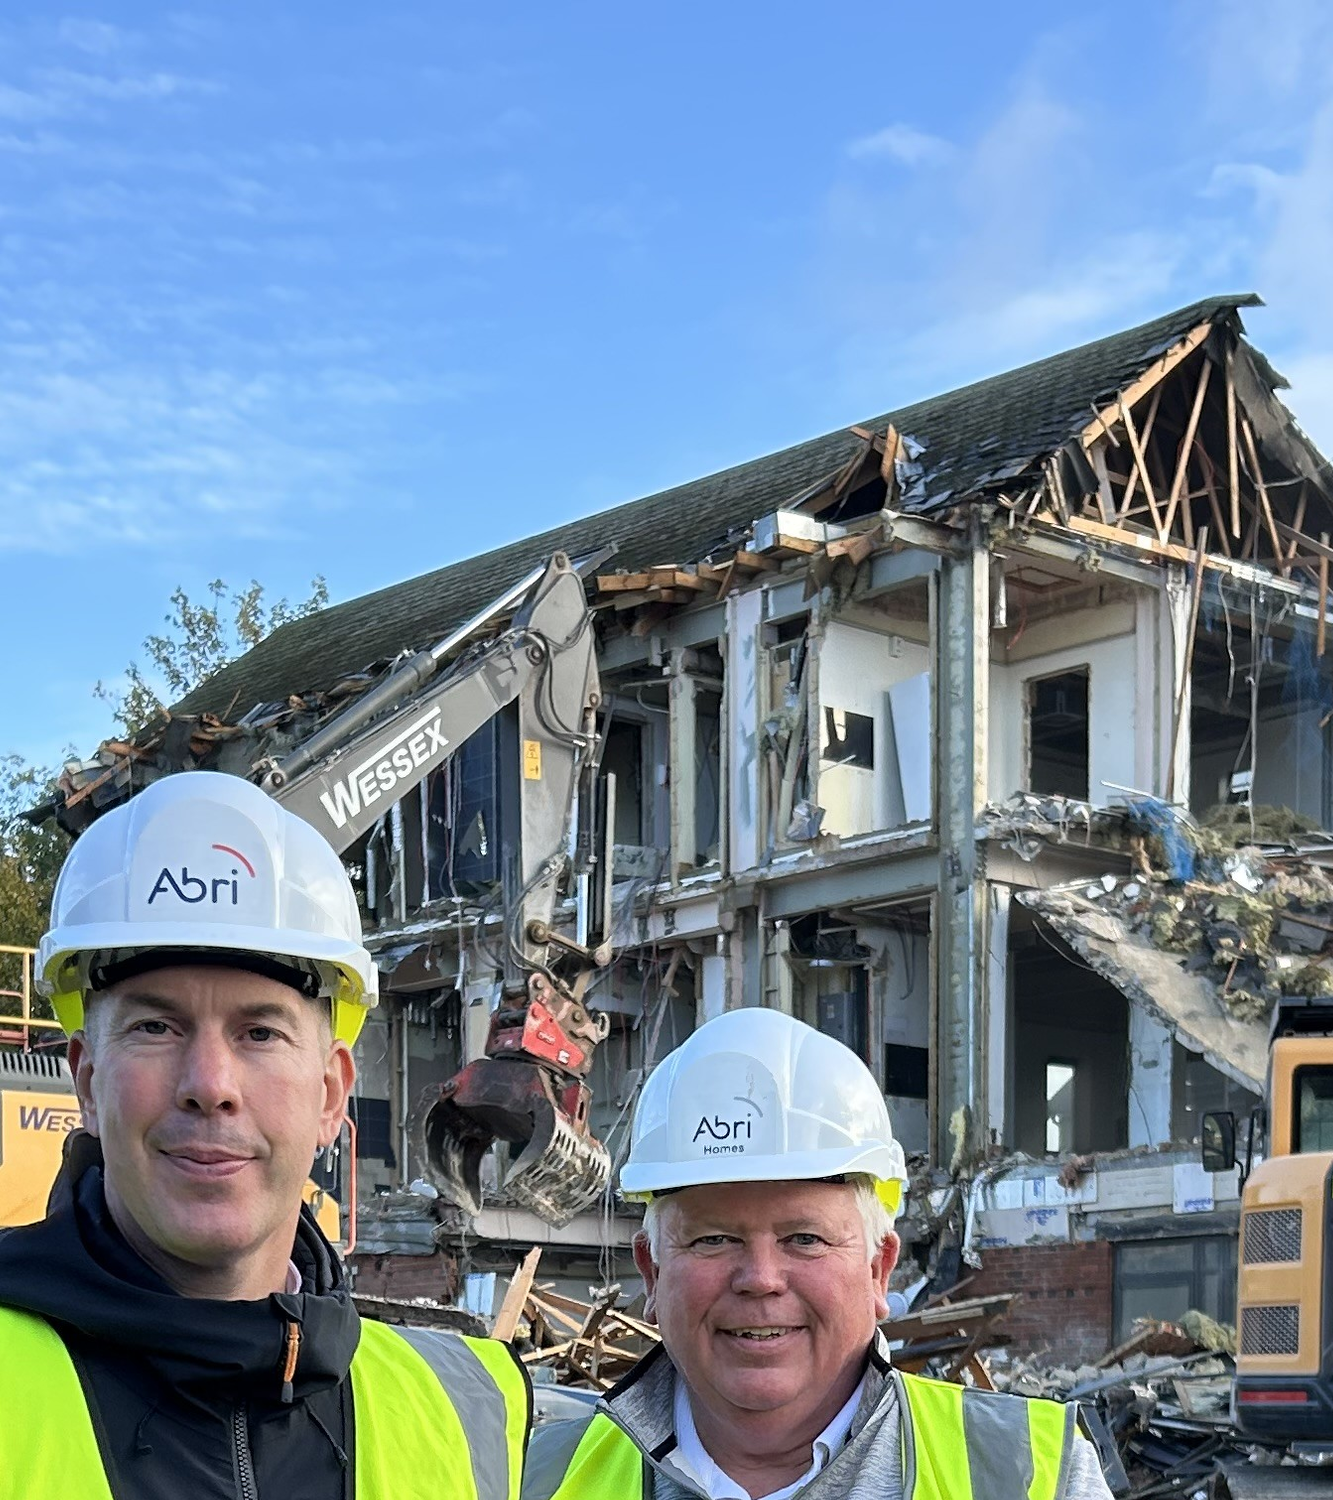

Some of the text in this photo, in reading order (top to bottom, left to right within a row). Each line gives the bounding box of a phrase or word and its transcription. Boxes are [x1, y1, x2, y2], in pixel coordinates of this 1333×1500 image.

[319, 706, 450, 829] WESSEX
[147, 867, 238, 905] Abri
[19, 1105, 84, 1133] WES
[692, 1113, 752, 1143] Abri
[703, 1144, 745, 1155] Homes
